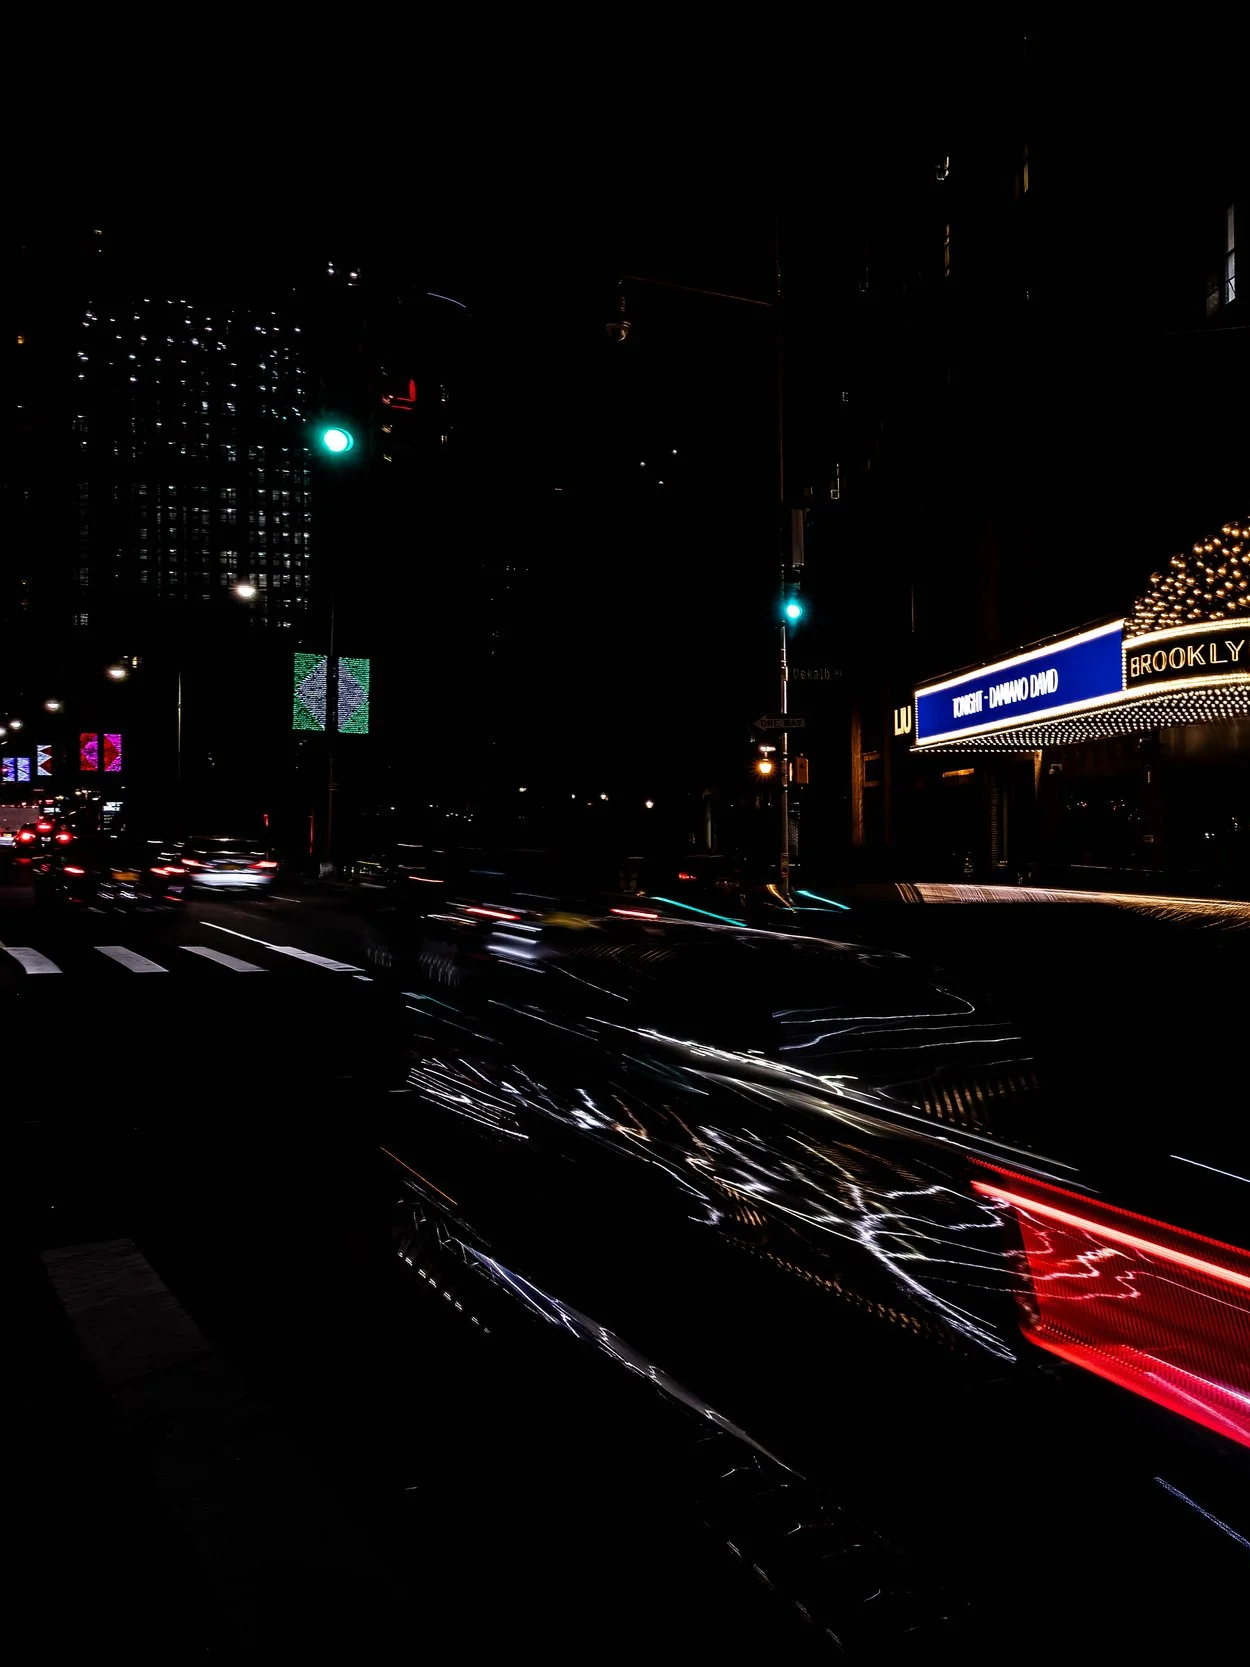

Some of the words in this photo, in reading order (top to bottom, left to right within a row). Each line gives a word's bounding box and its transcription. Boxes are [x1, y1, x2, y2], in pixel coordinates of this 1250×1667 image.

[952, 690, 983, 719] TONIGHT
[989, 677, 1029, 709] DAMIANO
[1030, 668, 1059, 699] DAVID
[894, 705, 912, 736] LIU
